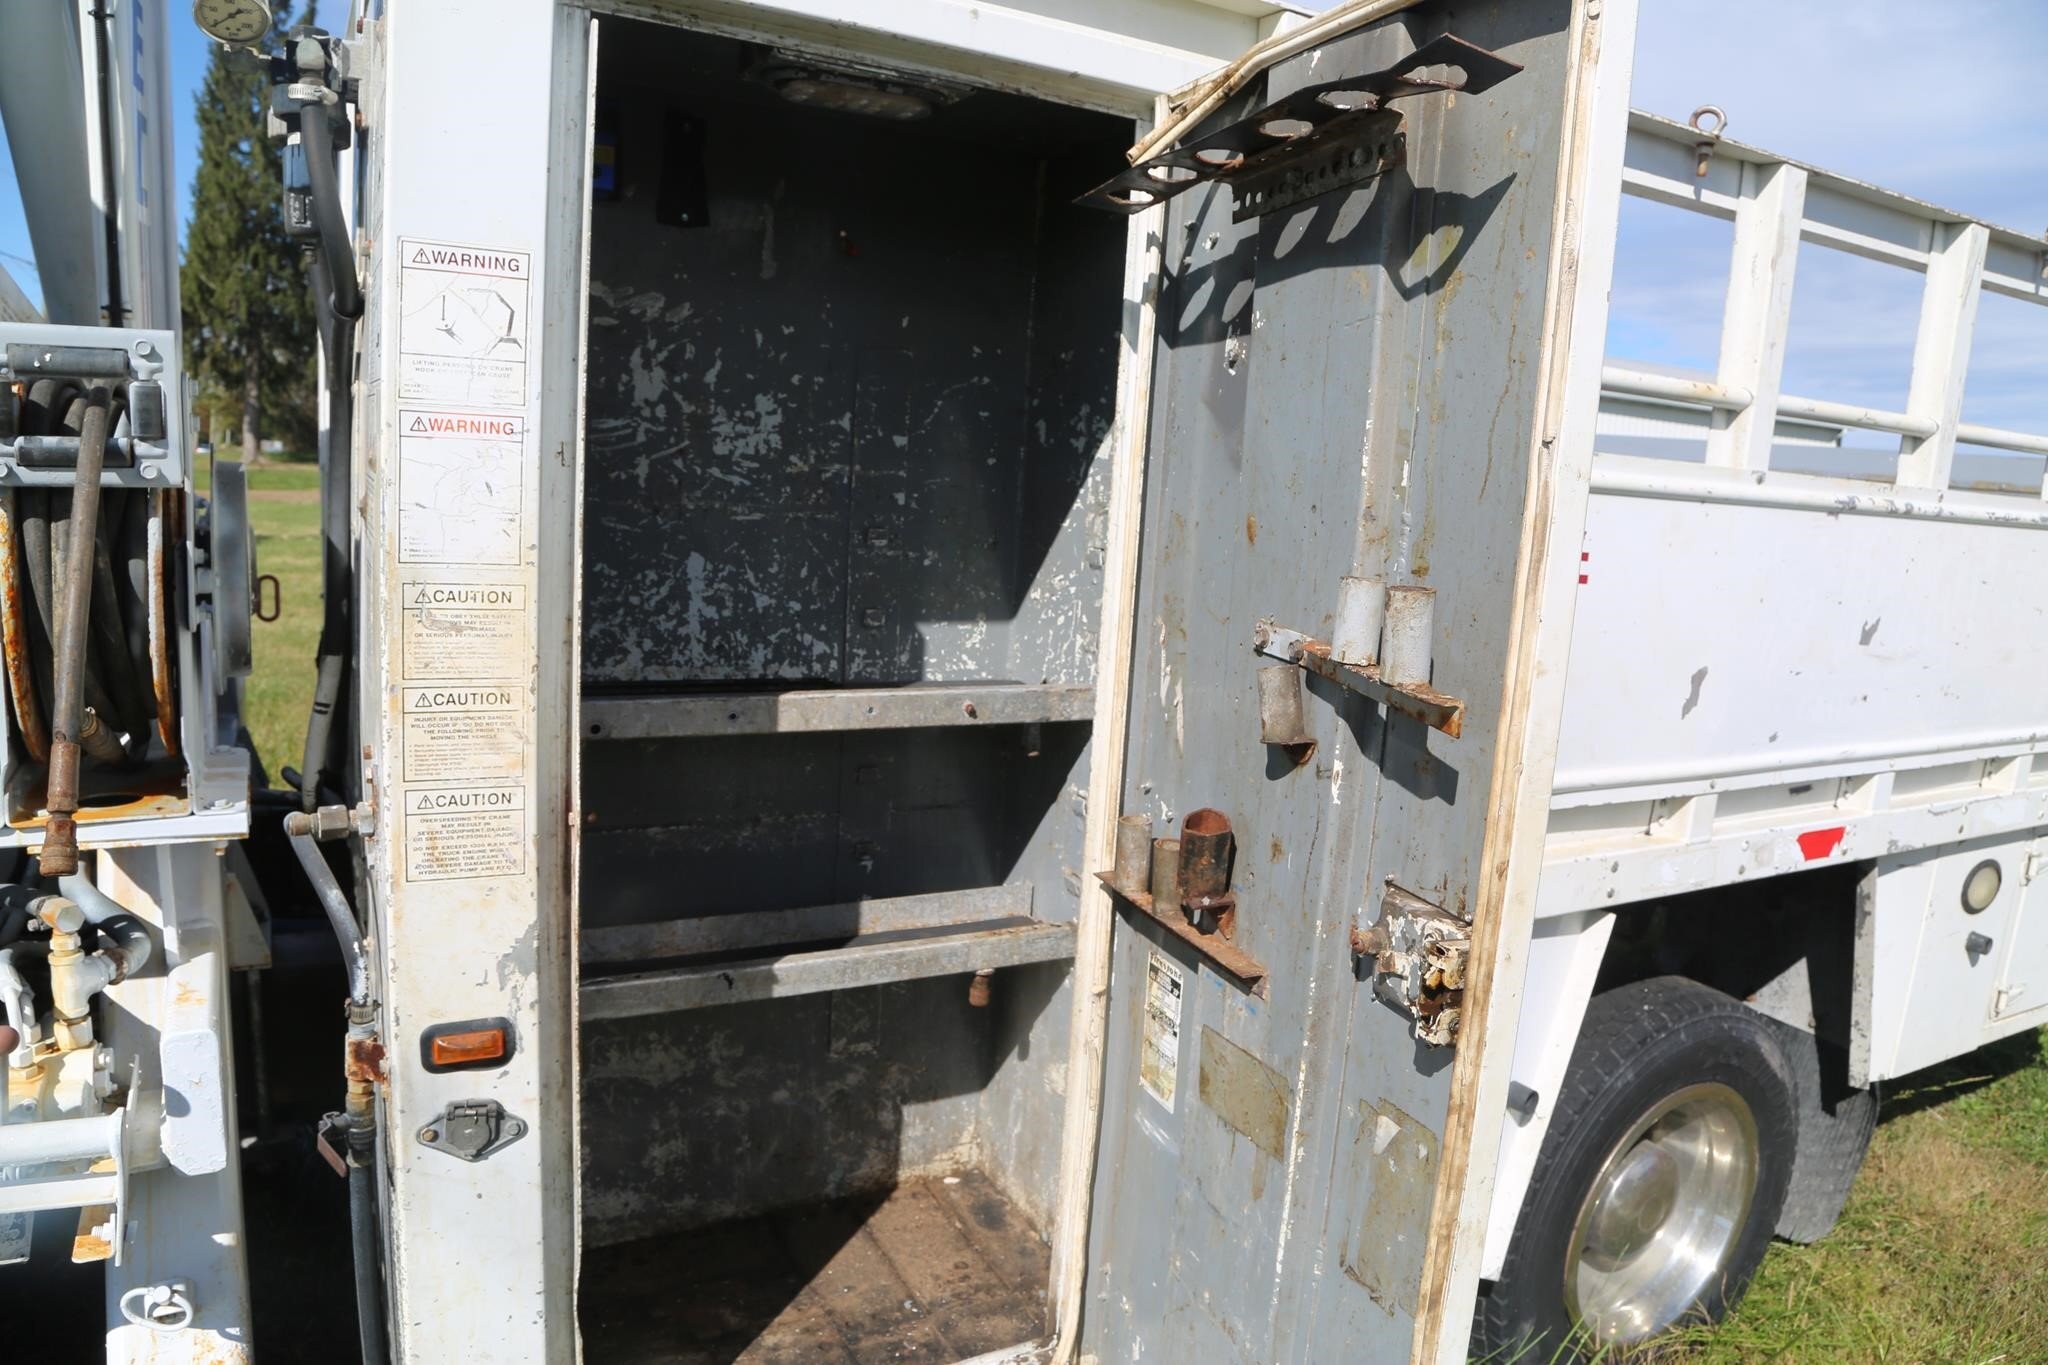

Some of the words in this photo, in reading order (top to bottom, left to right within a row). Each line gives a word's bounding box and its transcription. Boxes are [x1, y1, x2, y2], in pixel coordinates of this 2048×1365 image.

[431, 250, 520, 272] WARNING
[428, 418, 514, 435] WARNING
[434, 590, 512, 604] CAUTION
[434, 693, 511, 706] CAUTION
[436, 793, 512, 807] CAUTION
